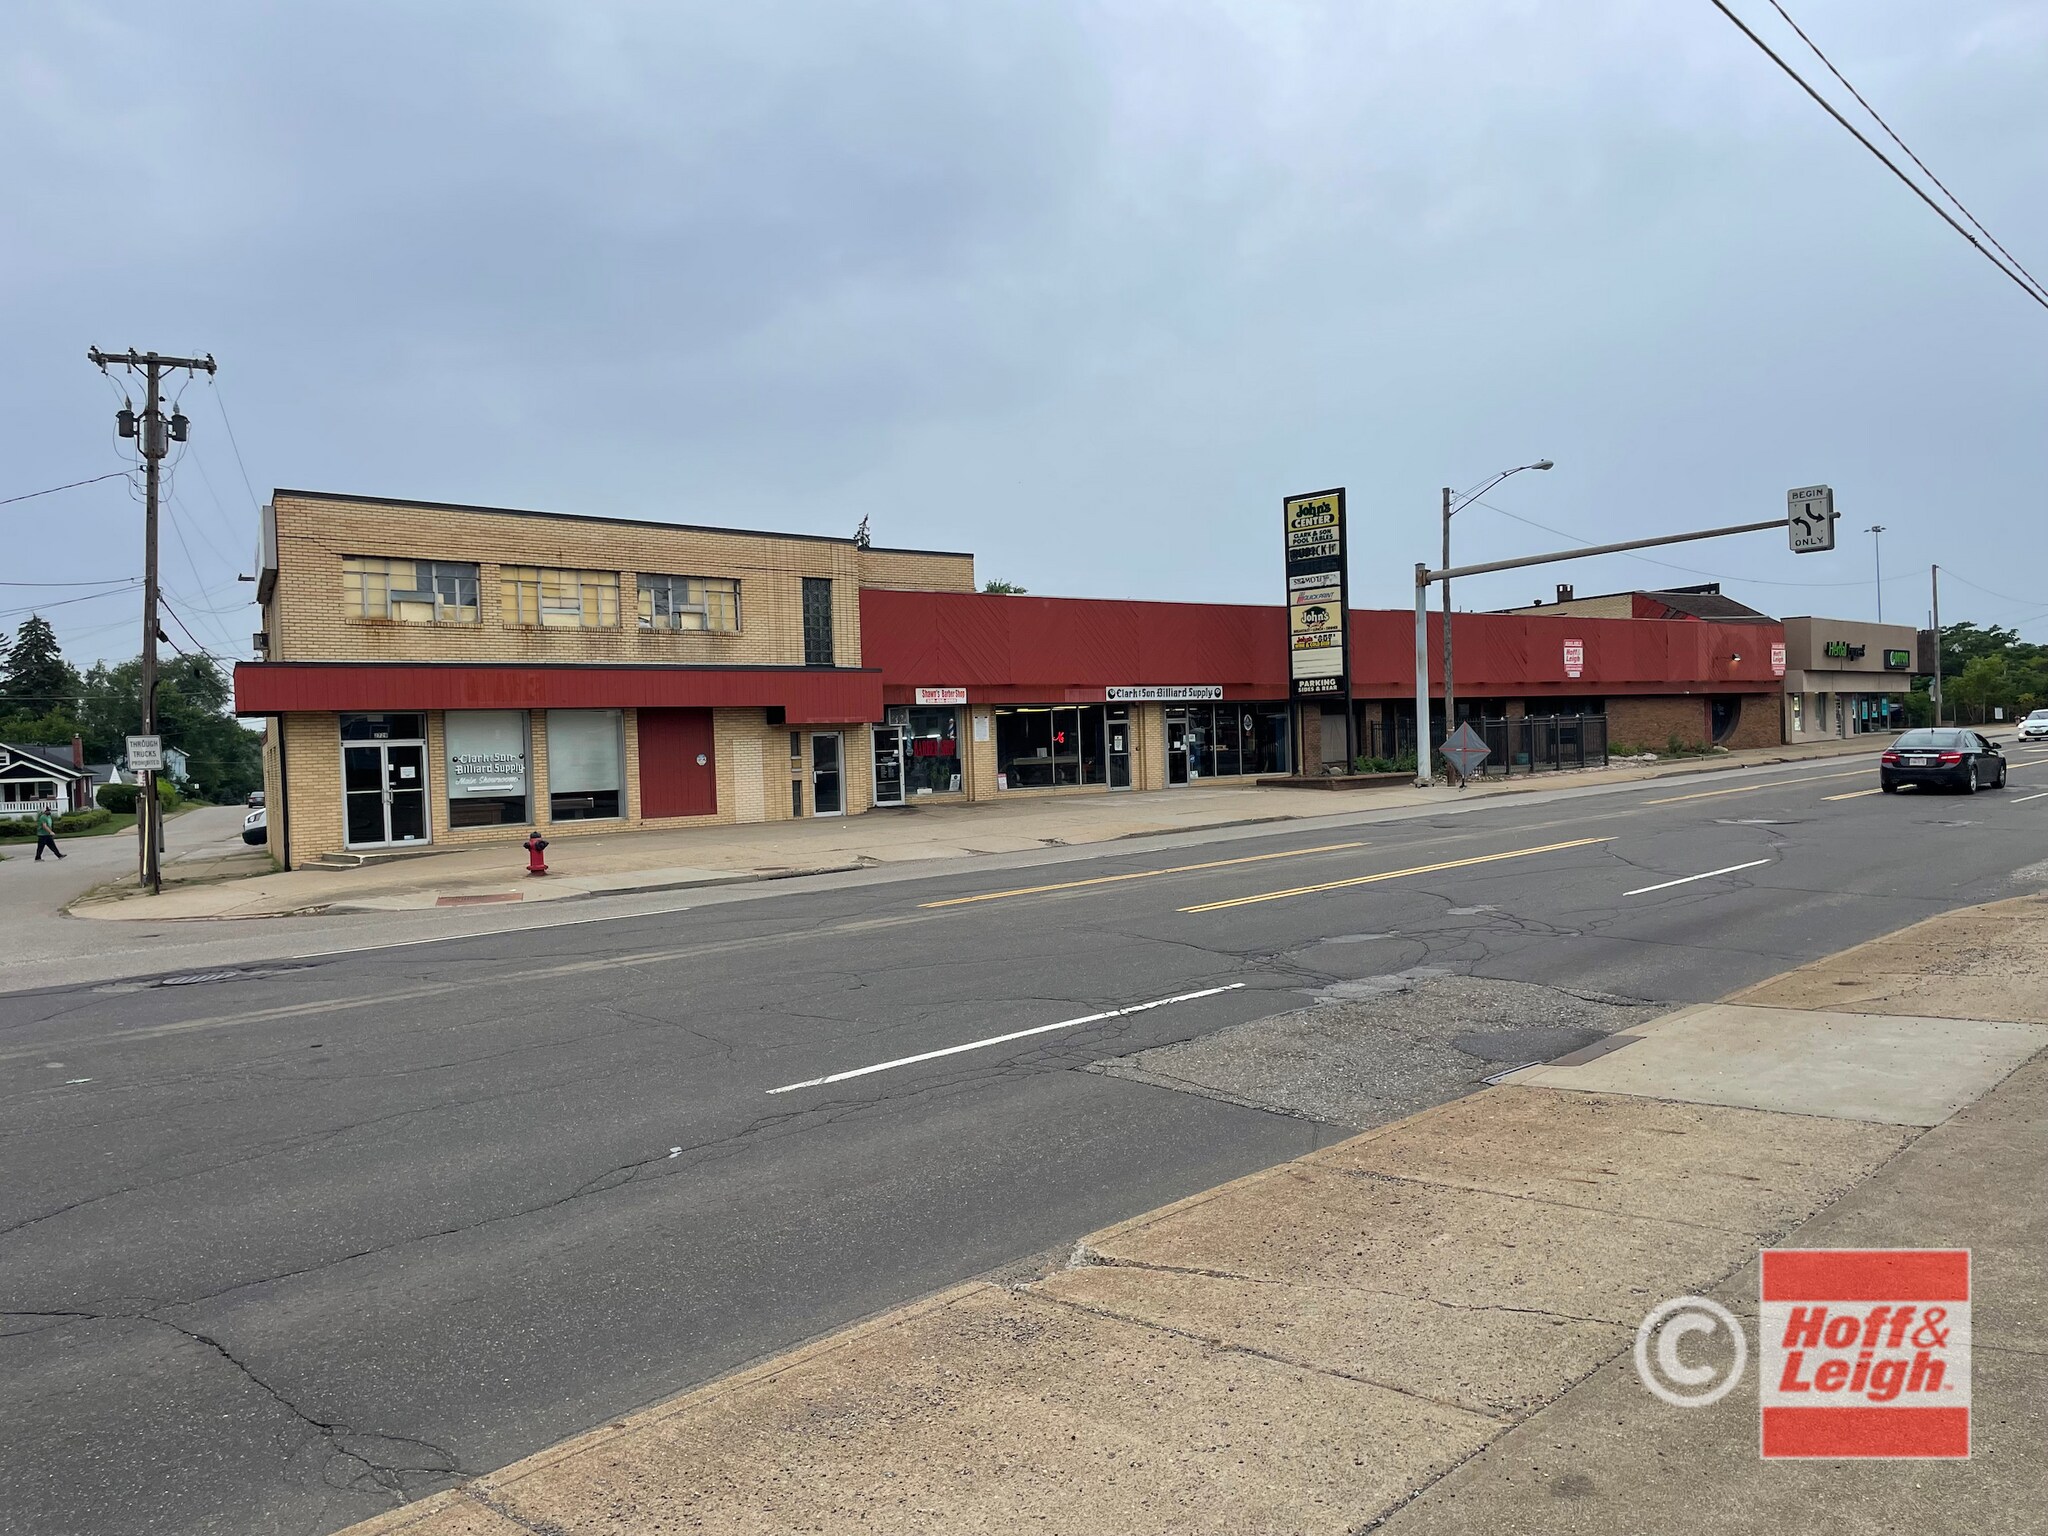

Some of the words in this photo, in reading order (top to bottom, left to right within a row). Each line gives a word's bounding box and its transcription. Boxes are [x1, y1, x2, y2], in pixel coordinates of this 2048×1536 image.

[1792, 489, 1823, 499] BEGIN
[1296, 502, 1332, 517] John's
[1294, 515, 1331, 528] CENTER
[1293, 531, 1312, 539] CLARK
[1311, 533, 1334, 543] TABLES
[1795, 536, 1824, 547] ONLY
[1301, 610, 1329, 623] John's
[1566, 655, 1581, 663] Leigh
[1299, 678, 1336, 687] PARKING
[921, 689, 941, 698] Shawn's
[941, 689, 955, 698] Barber
[955, 689, 965, 698] Shop
[1116, 688, 1138, 698] Clark
[1141, 688, 1156, 698] Son
[1156, 687, 1187, 698] Billiard
[1188, 687, 1214, 699] Supply
[130, 740, 159, 748] THROUGH
[133, 750, 157, 758] TRUCKS
[493, 752, 517, 762] Son
[455, 764, 493, 775] Billiard
[493, 762, 526, 774] Supply
[455, 776, 477, 786] Main
[478, 775, 519, 784] Showroom
